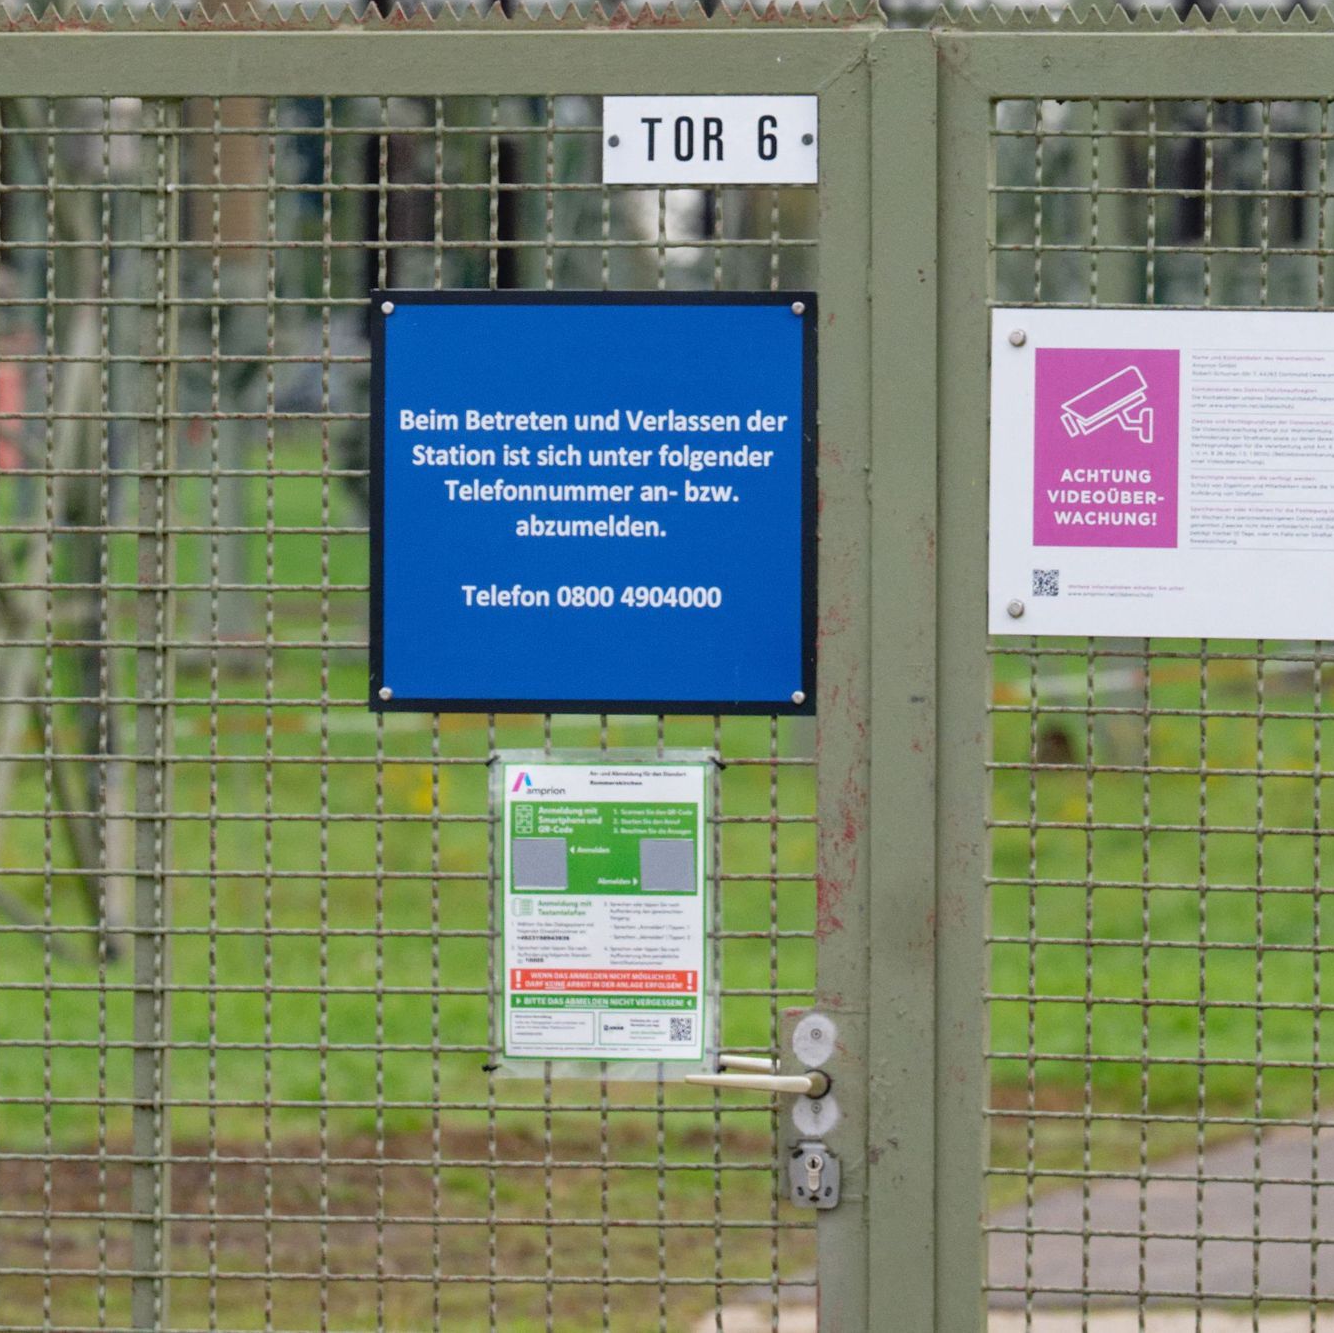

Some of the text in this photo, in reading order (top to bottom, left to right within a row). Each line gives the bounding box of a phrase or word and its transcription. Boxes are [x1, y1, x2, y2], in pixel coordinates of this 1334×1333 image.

[641, 115, 777, 162] TOR 6
[400, 409, 788, 432] Beim Betreten und Verlassen der
[412, 444, 774, 471] Station ist sich unter folgender
[1061, 469, 1151, 483] ACHTUNG
[444, 479, 739, 502] Telefonnummer an- bzw.
[1047, 488, 1164, 504] VIDEOÜBER-
[516, 514, 666, 537] abzumelden.
[1054, 511, 1156, 526] WACHUNG!
[462, 584, 722, 608] Telefon 0800 4904000
[527, 787, 565, 796] amprion
